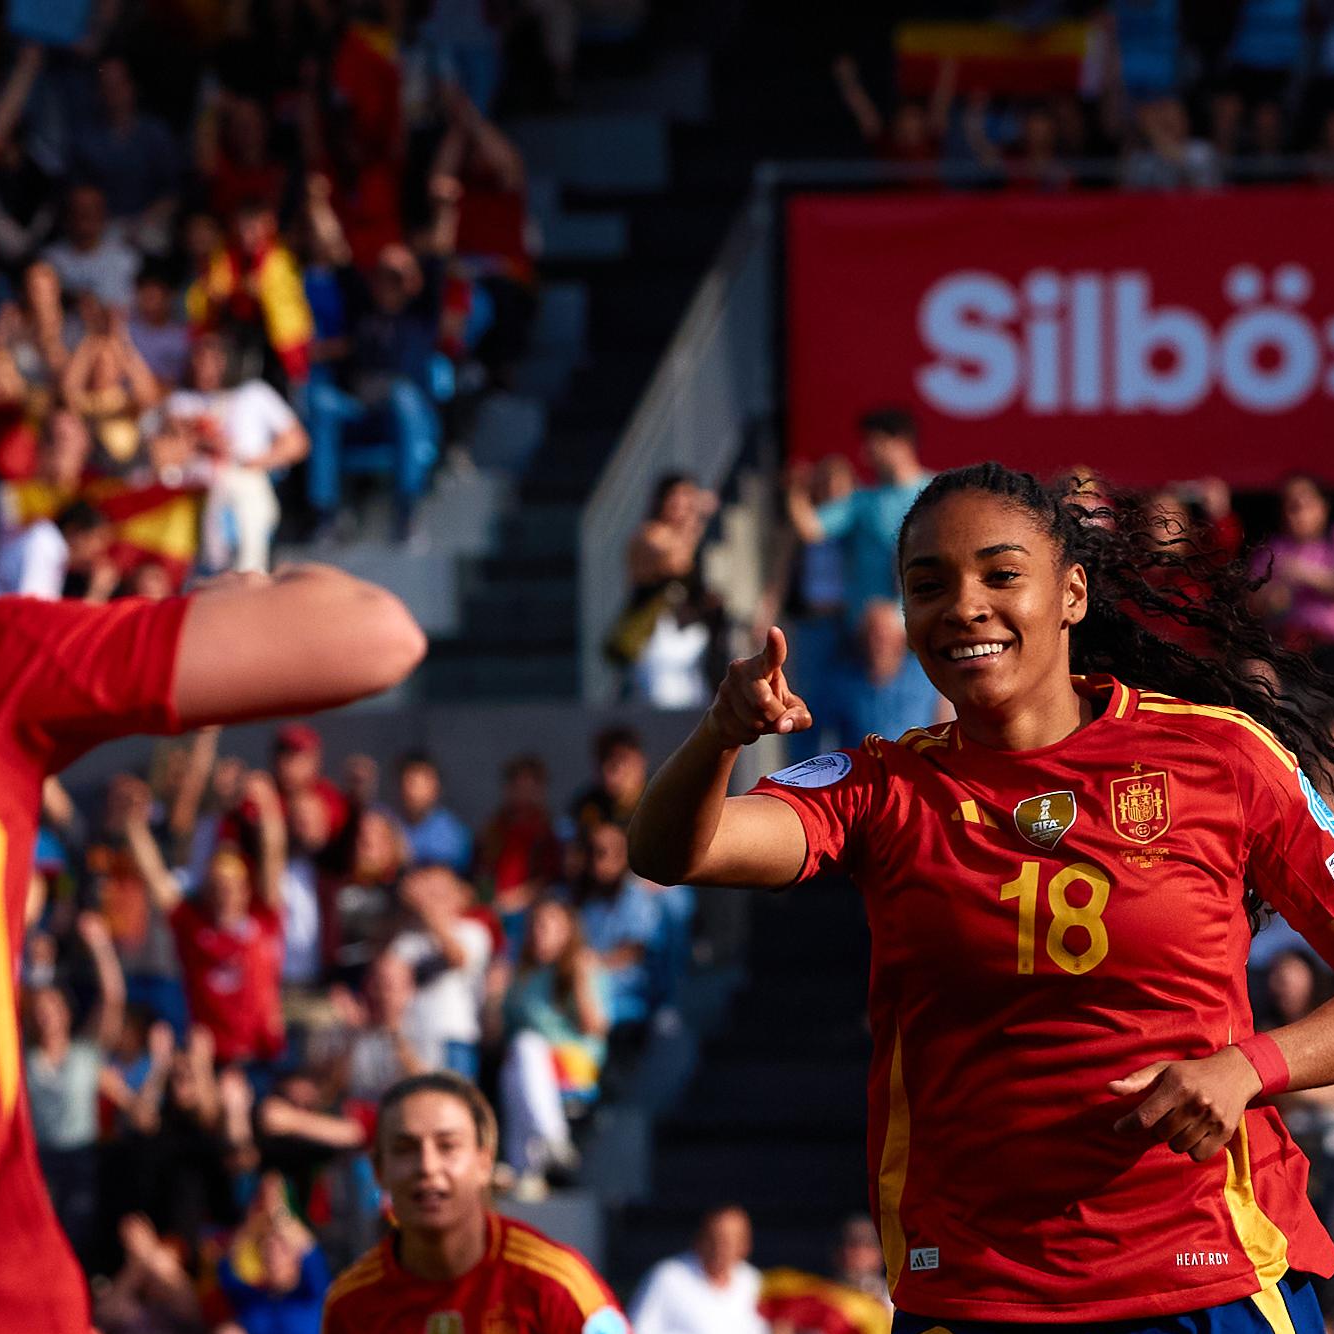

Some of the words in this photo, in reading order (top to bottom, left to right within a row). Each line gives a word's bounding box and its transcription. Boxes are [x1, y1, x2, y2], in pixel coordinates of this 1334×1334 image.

[1032, 819, 1058, 833] FIFA
[999, 861, 1110, 975] 18
[1176, 1252, 1229, 1266] HEAT.RDY
